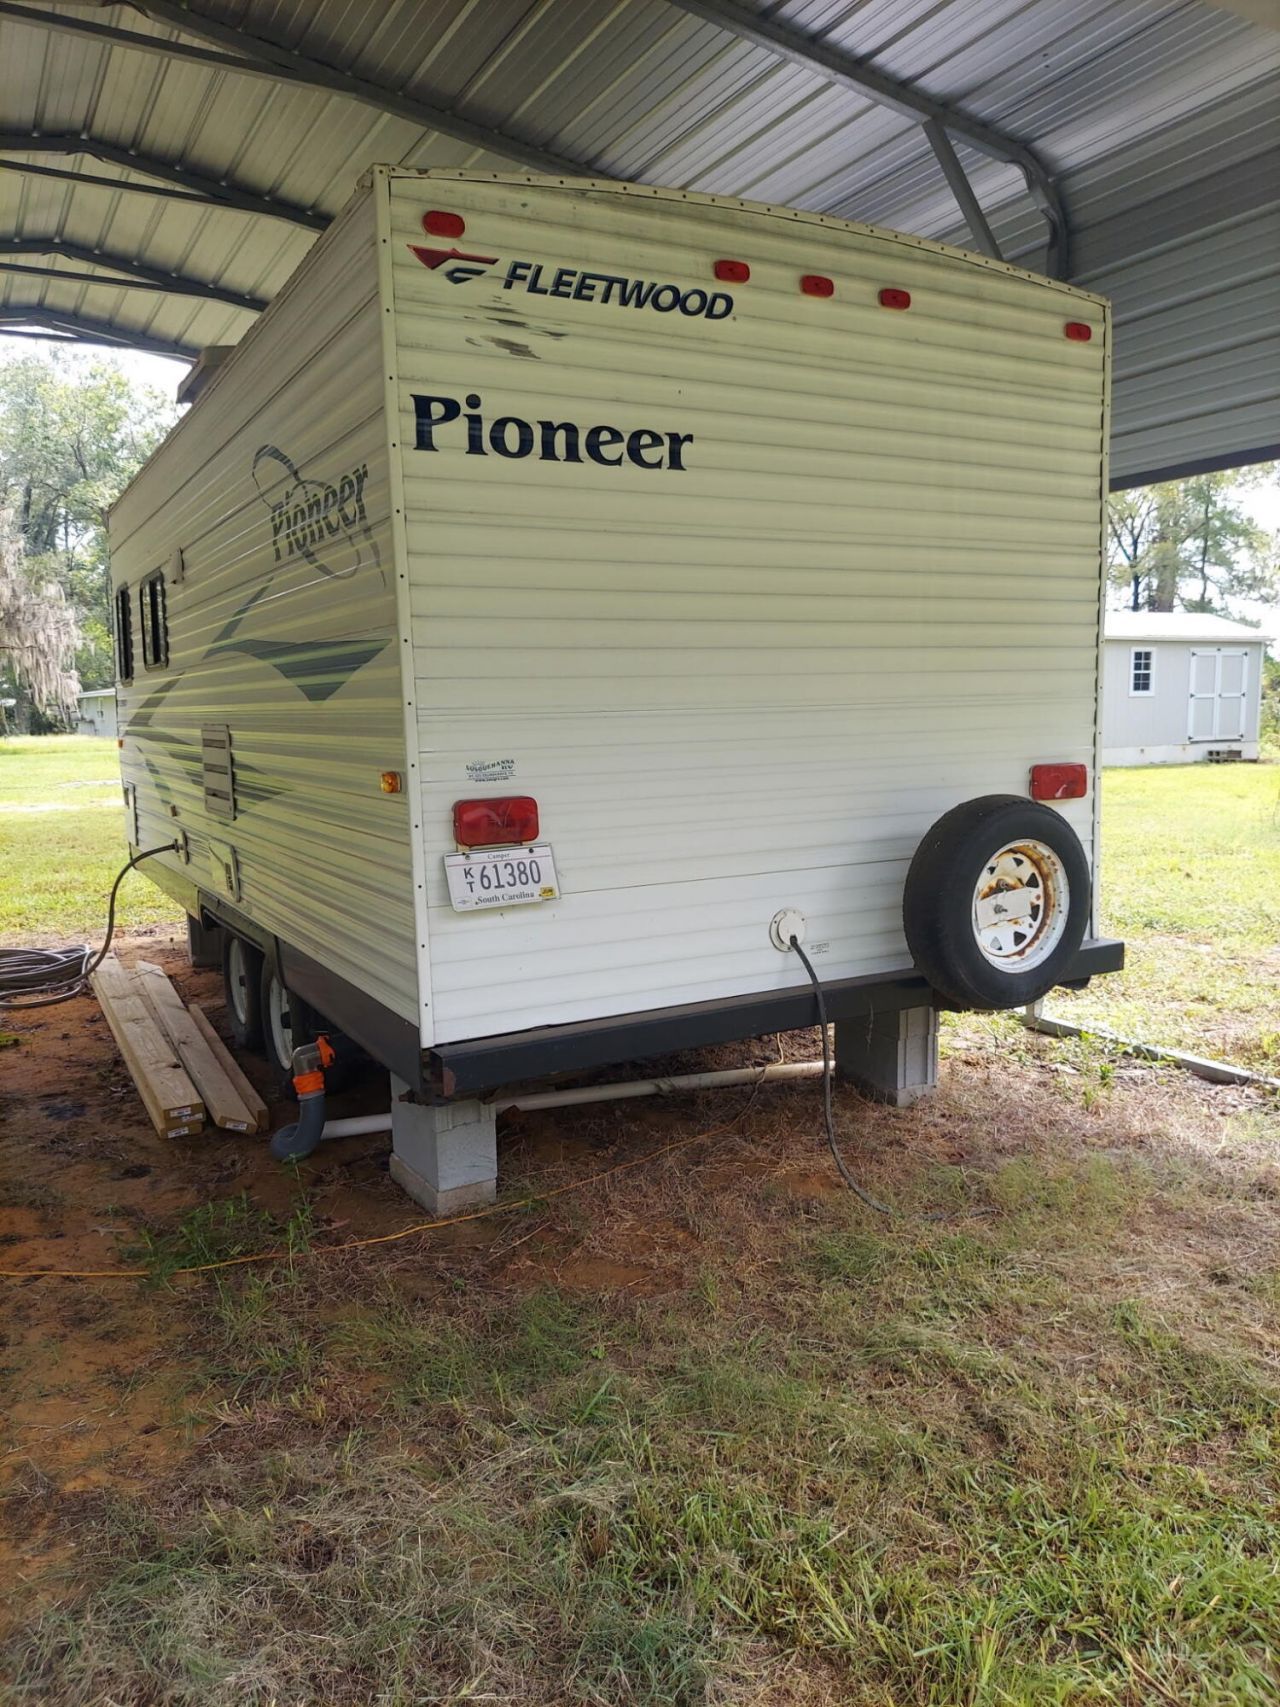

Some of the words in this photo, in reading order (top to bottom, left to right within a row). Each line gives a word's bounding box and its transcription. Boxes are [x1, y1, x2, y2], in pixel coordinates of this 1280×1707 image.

[503, 261, 735, 320] FLEETWOOD
[410, 393, 694, 471] Pioneer
[480, 859, 542, 890] 61380
[477, 893, 501, 904] South
[502, 891, 535, 903] Carolina
